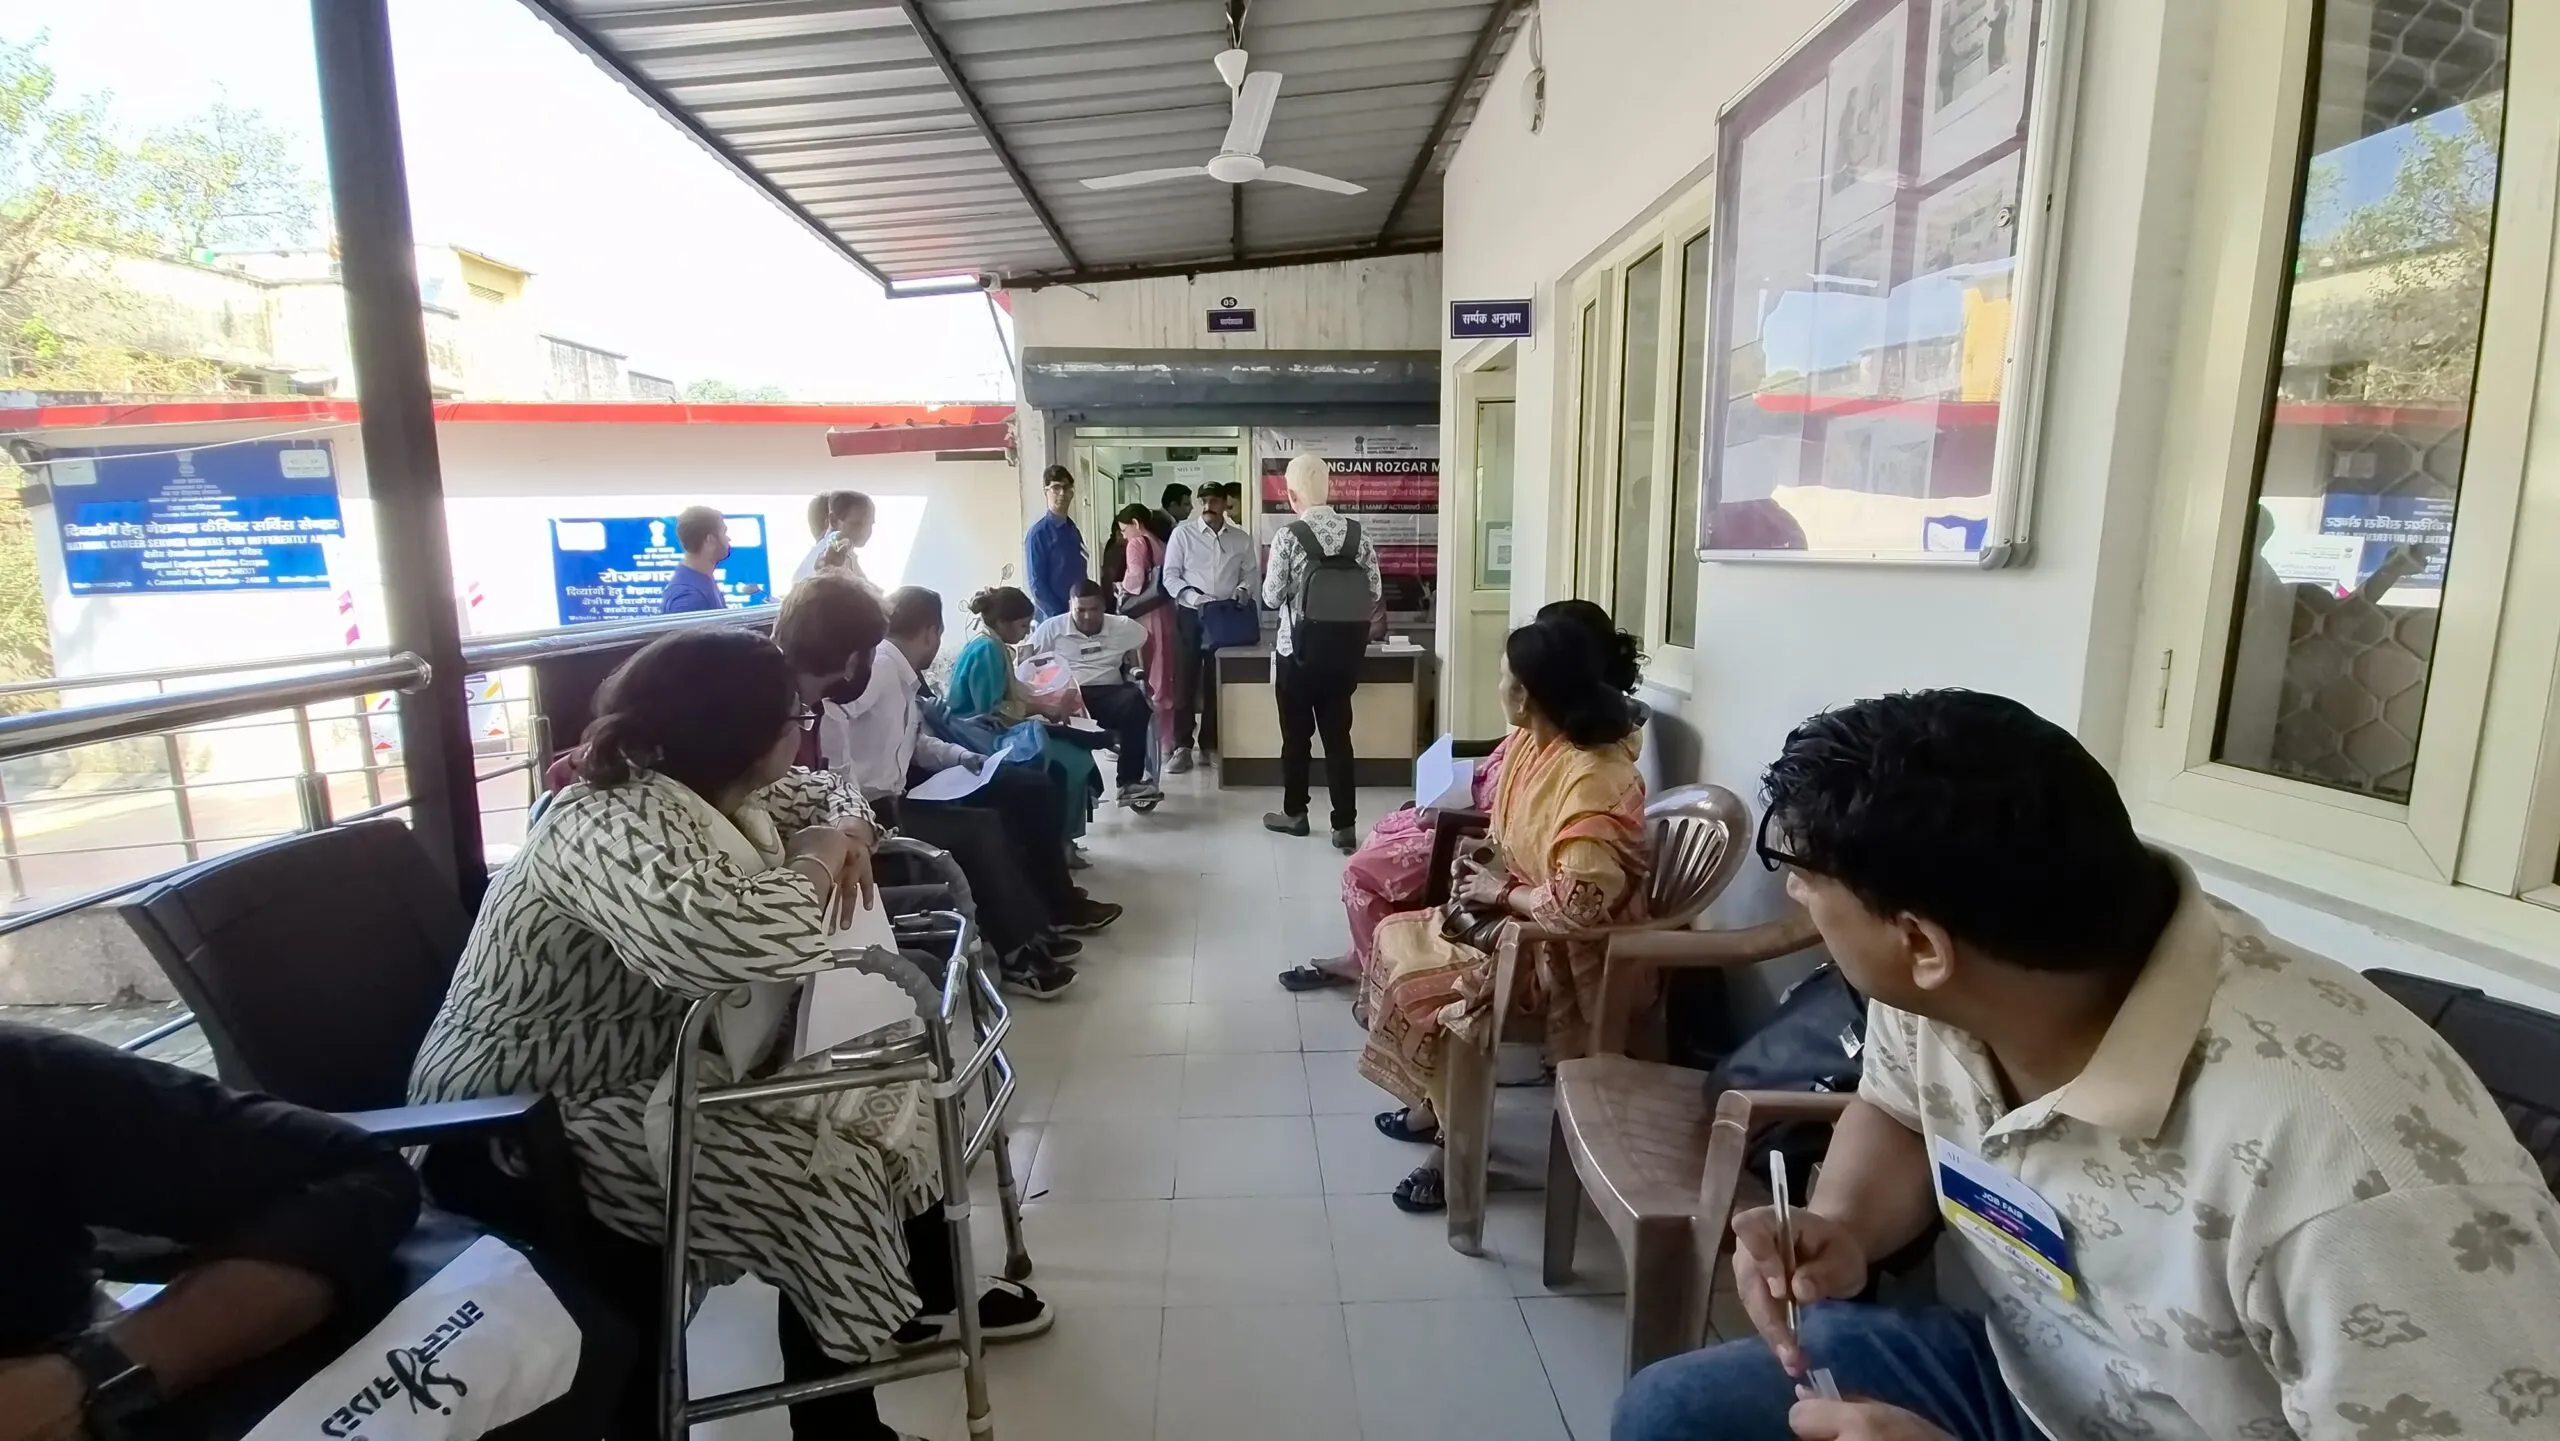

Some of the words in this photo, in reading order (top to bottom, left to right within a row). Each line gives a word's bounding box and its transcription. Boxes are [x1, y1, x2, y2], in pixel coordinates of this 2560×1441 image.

[1491, 312, 1522, 328] अनुभाग
[1375, 461, 1428, 473] ROZGAR
[110, 539, 146, 549] CAREER
[1982, 1191, 2001, 1207] JOB
[2002, 1202, 2024, 1220] FAIR
